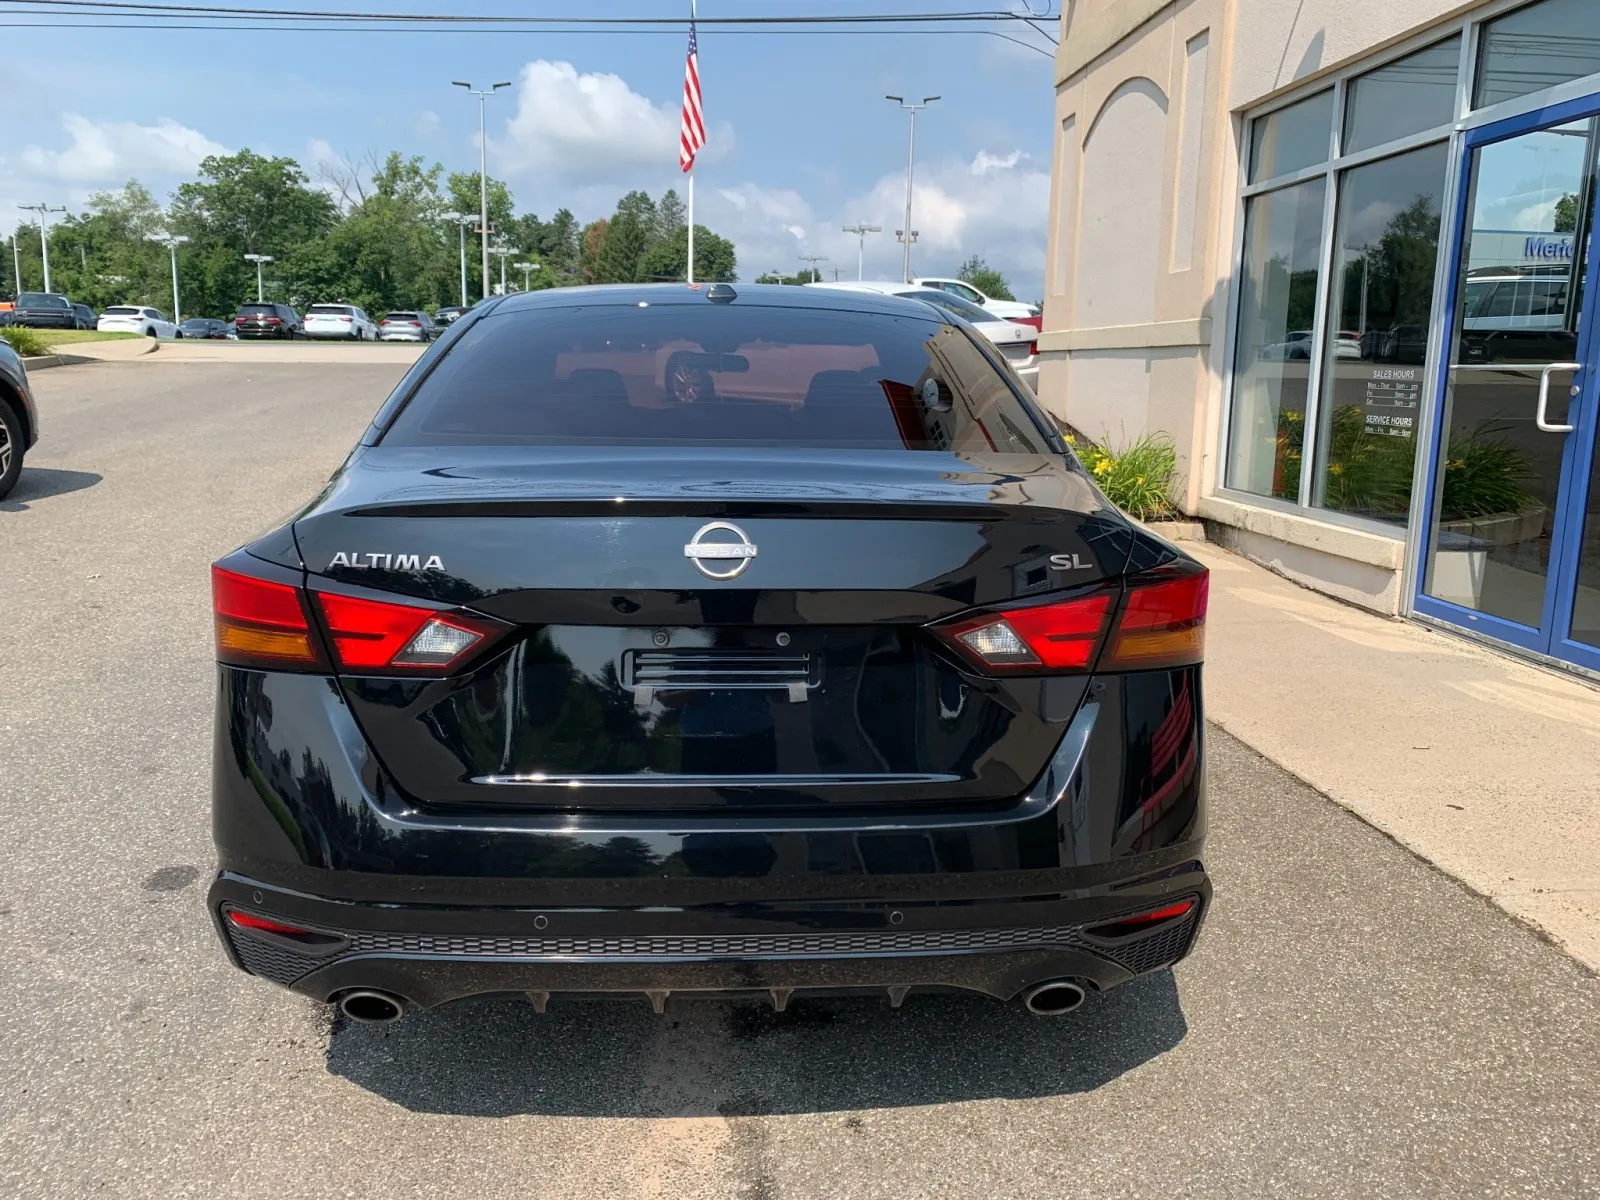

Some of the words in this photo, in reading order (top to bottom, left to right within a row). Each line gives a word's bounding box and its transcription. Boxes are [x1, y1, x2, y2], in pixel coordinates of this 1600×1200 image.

[1373, 370, 1392, 379] SALES
[1392, 370, 1415, 379] HOURS
[1366, 414, 1390, 424] SERVICE
[1390, 416, 1412, 426] HOURS
[686, 547, 756, 556] NISSAN
[329, 551, 446, 571] ALTIMA
[1050, 553, 1093, 570] SL
